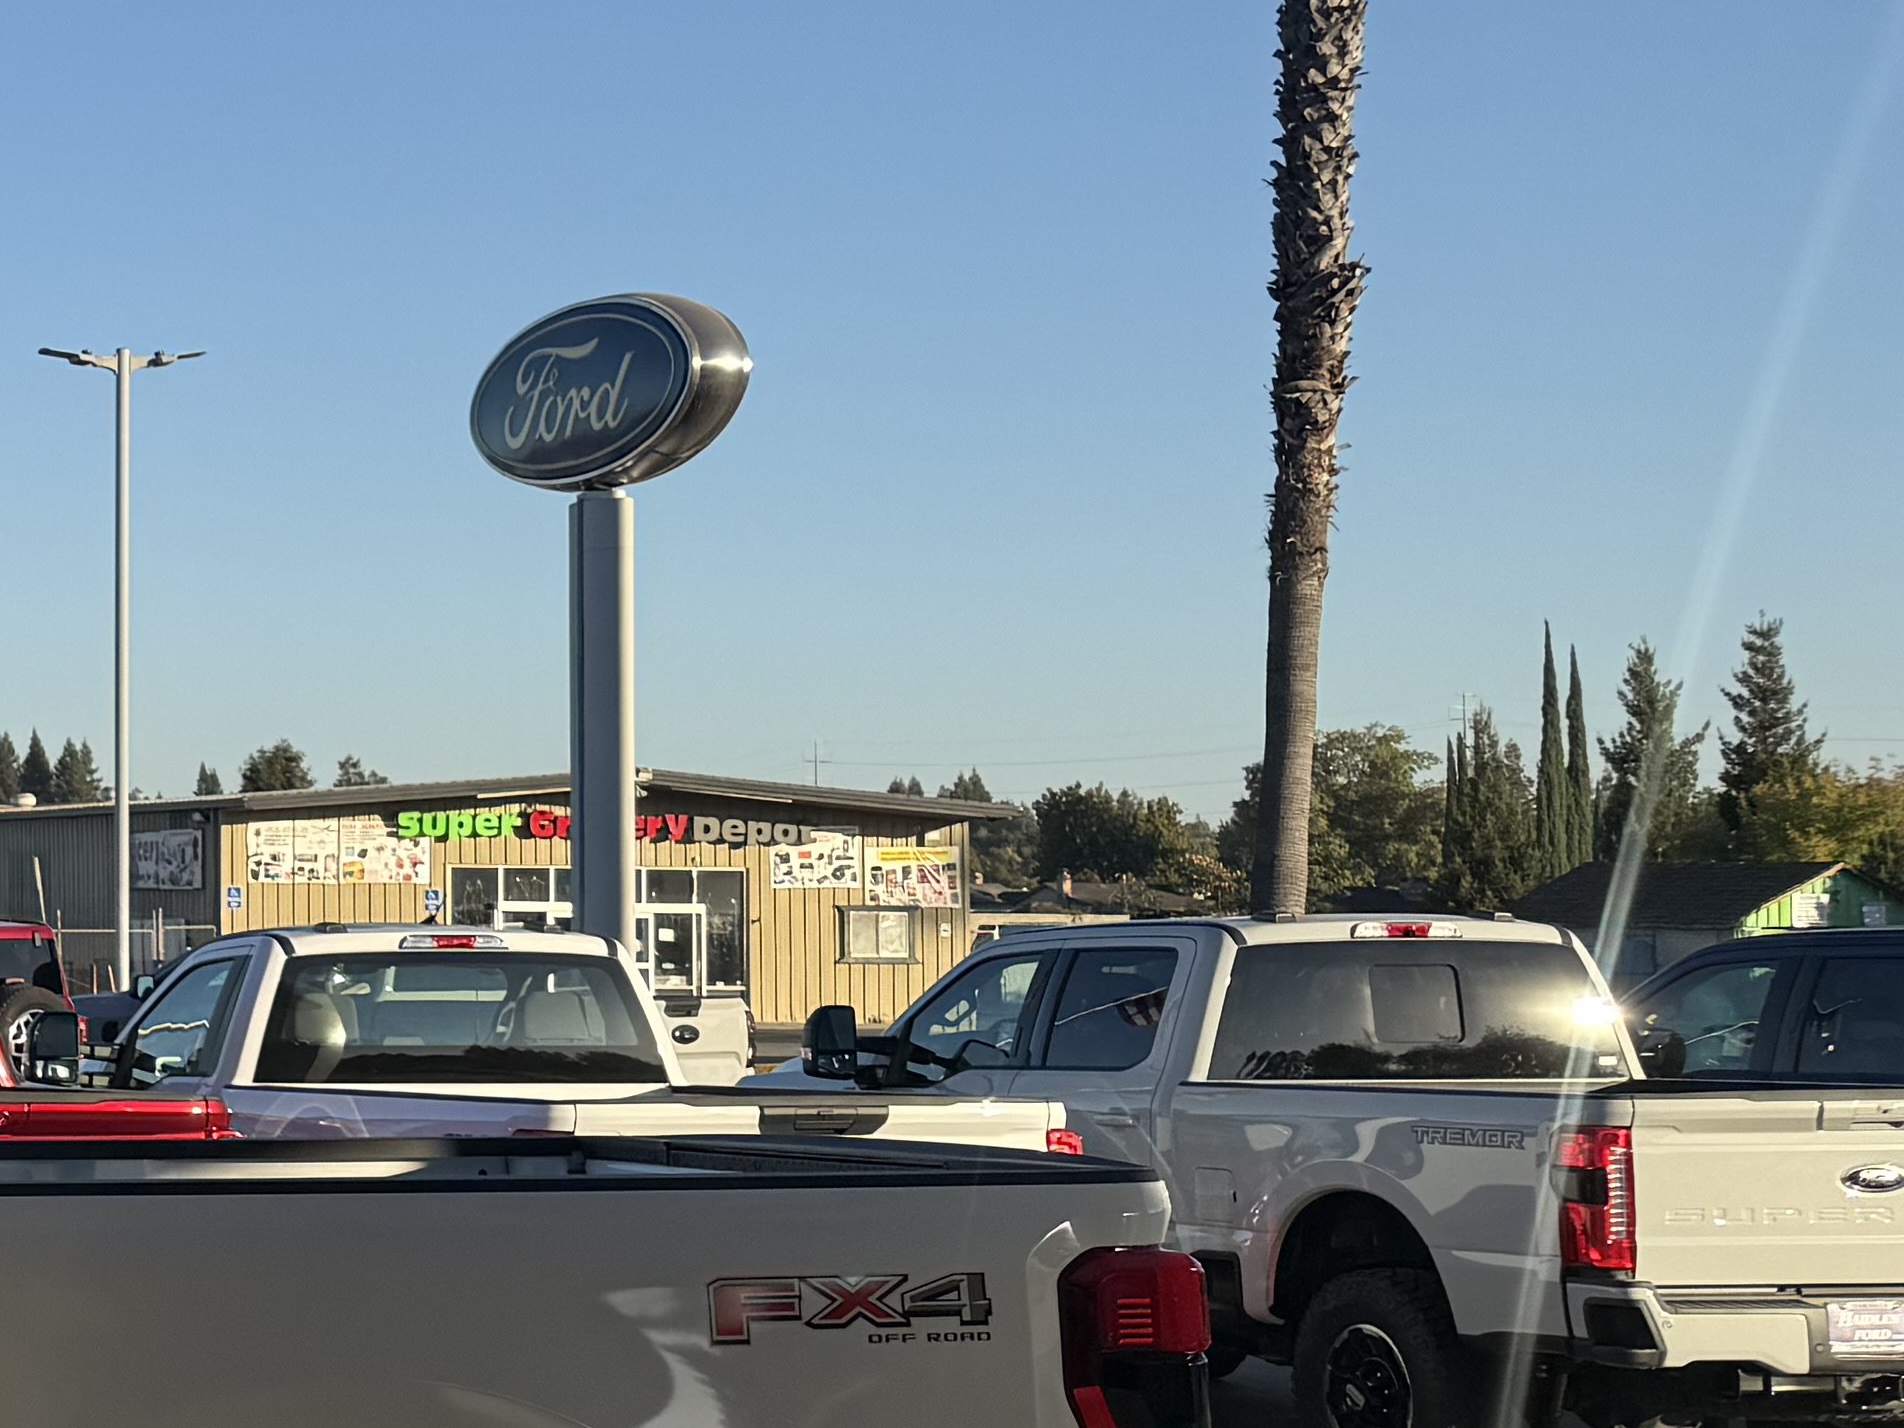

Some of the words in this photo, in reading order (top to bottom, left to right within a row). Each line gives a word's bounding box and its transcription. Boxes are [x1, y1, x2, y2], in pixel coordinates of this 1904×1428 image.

[505, 337, 635, 450] Ford
[1411, 1125, 1526, 1150] TREMOR
[1664, 1207, 1894, 1225] SUPER
[707, 1272, 992, 1346] FX4
[868, 1333, 916, 1344] OFF
[926, 1331, 992, 1342] ROAD
